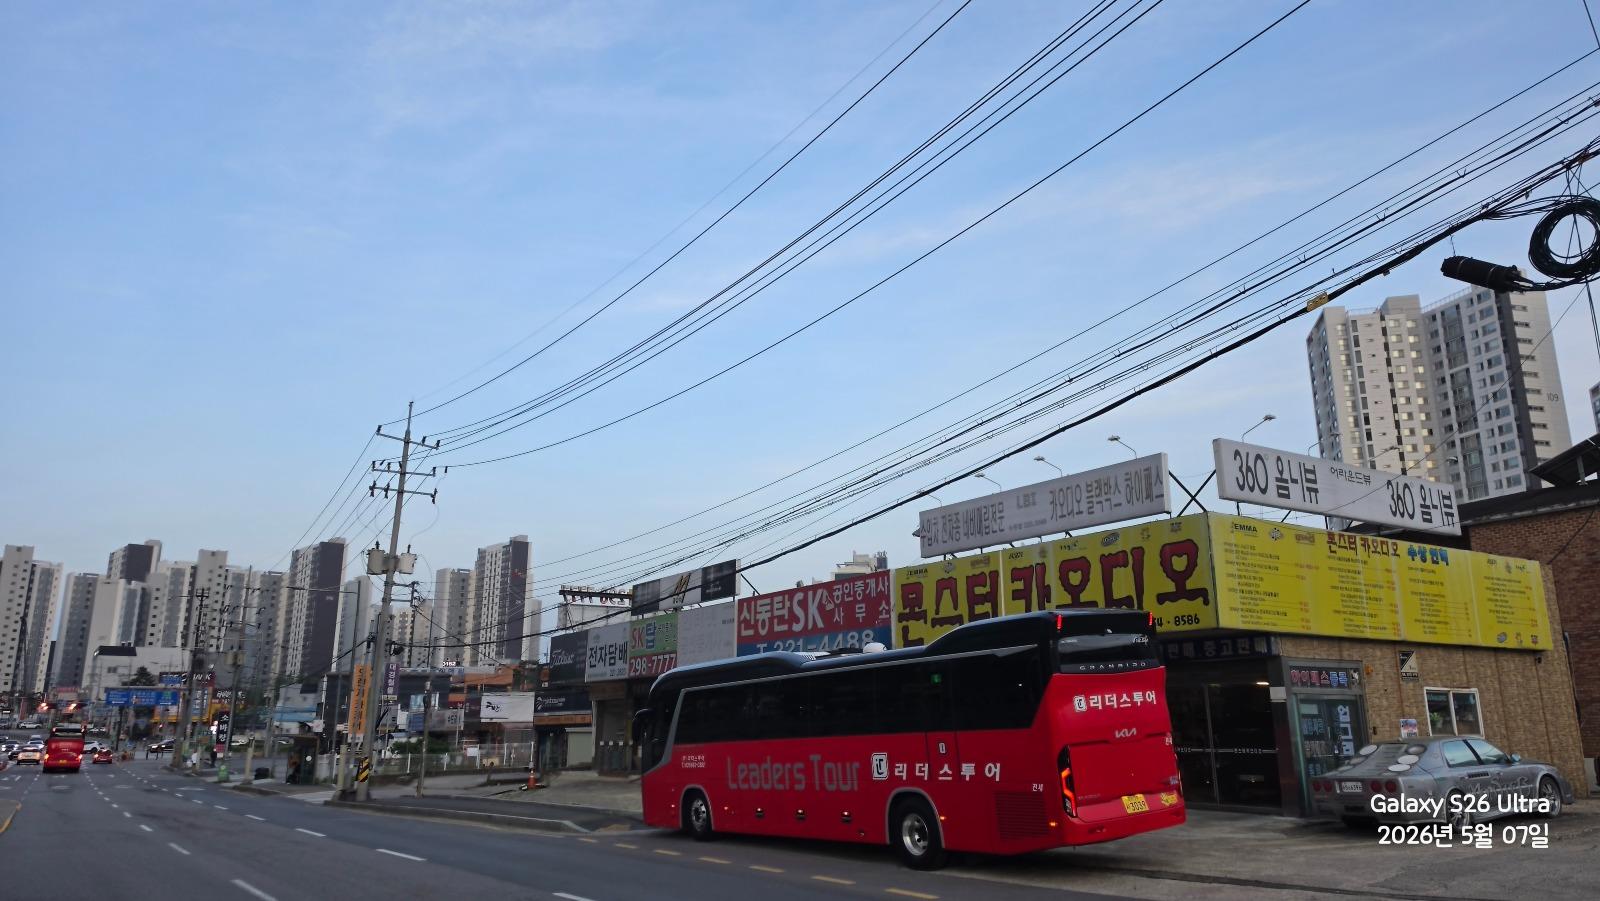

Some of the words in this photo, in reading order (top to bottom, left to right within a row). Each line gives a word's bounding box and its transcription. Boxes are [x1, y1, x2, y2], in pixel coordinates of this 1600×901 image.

[1547, 392, 1559, 402] 109
[1274, 454, 1320, 505] 옴니뷰
[1330, 466, 1372, 486] 어라운드뷰
[1049, 484, 1084, 522] 카오디오
[1085, 473, 1122, 515] 블랙박스
[1124, 465, 1165, 506] 하이패스
[1418, 483, 1456, 528] 옴니뷰
[1360, 535, 1401, 559] 카오디오
[832, 575, 889, 604] 공인중개사
[1174, 613, 1200, 626] 8586
[587, 641, 629, 669] 전자담배
[629, 653, 676, 677] 298-7777
[1088, 690, 1157, 710] 리더스투어
[1114, 727, 1137, 738] KIA
[726, 755, 806, 792] Leaders
[809, 753, 860, 792] Tour
[894, 762, 1001, 782] 리더스투어
